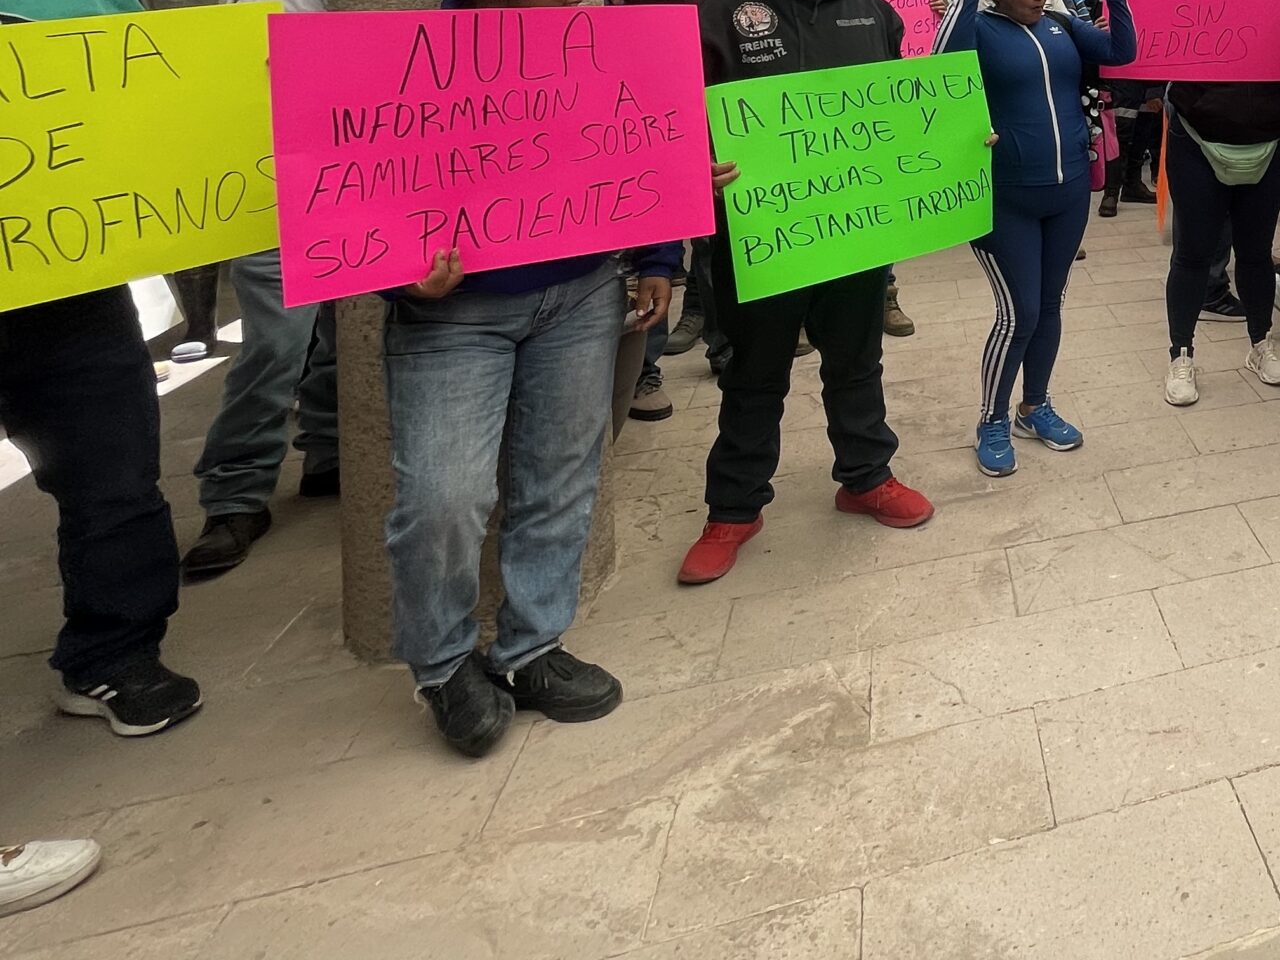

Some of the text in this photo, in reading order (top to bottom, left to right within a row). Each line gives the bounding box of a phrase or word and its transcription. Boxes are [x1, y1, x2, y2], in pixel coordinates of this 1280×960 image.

[739, 38, 783, 53] FRENTE
[1170, 1, 1226, 29] SIN
[0, 23, 180, 103] LTA
[400, 11, 606, 95] NULA
[331, 80, 642, 147] INFORMACION A
[721, 96, 766, 138] LA
[943, 74, 984, 100] EN
[306, 110, 686, 214] FAMILIARES SOBRE
[897, 150, 942, 174] ES
[738, 168, 991, 267] BASTANTE TARDADA
[305, 227, 390, 279] SUS
